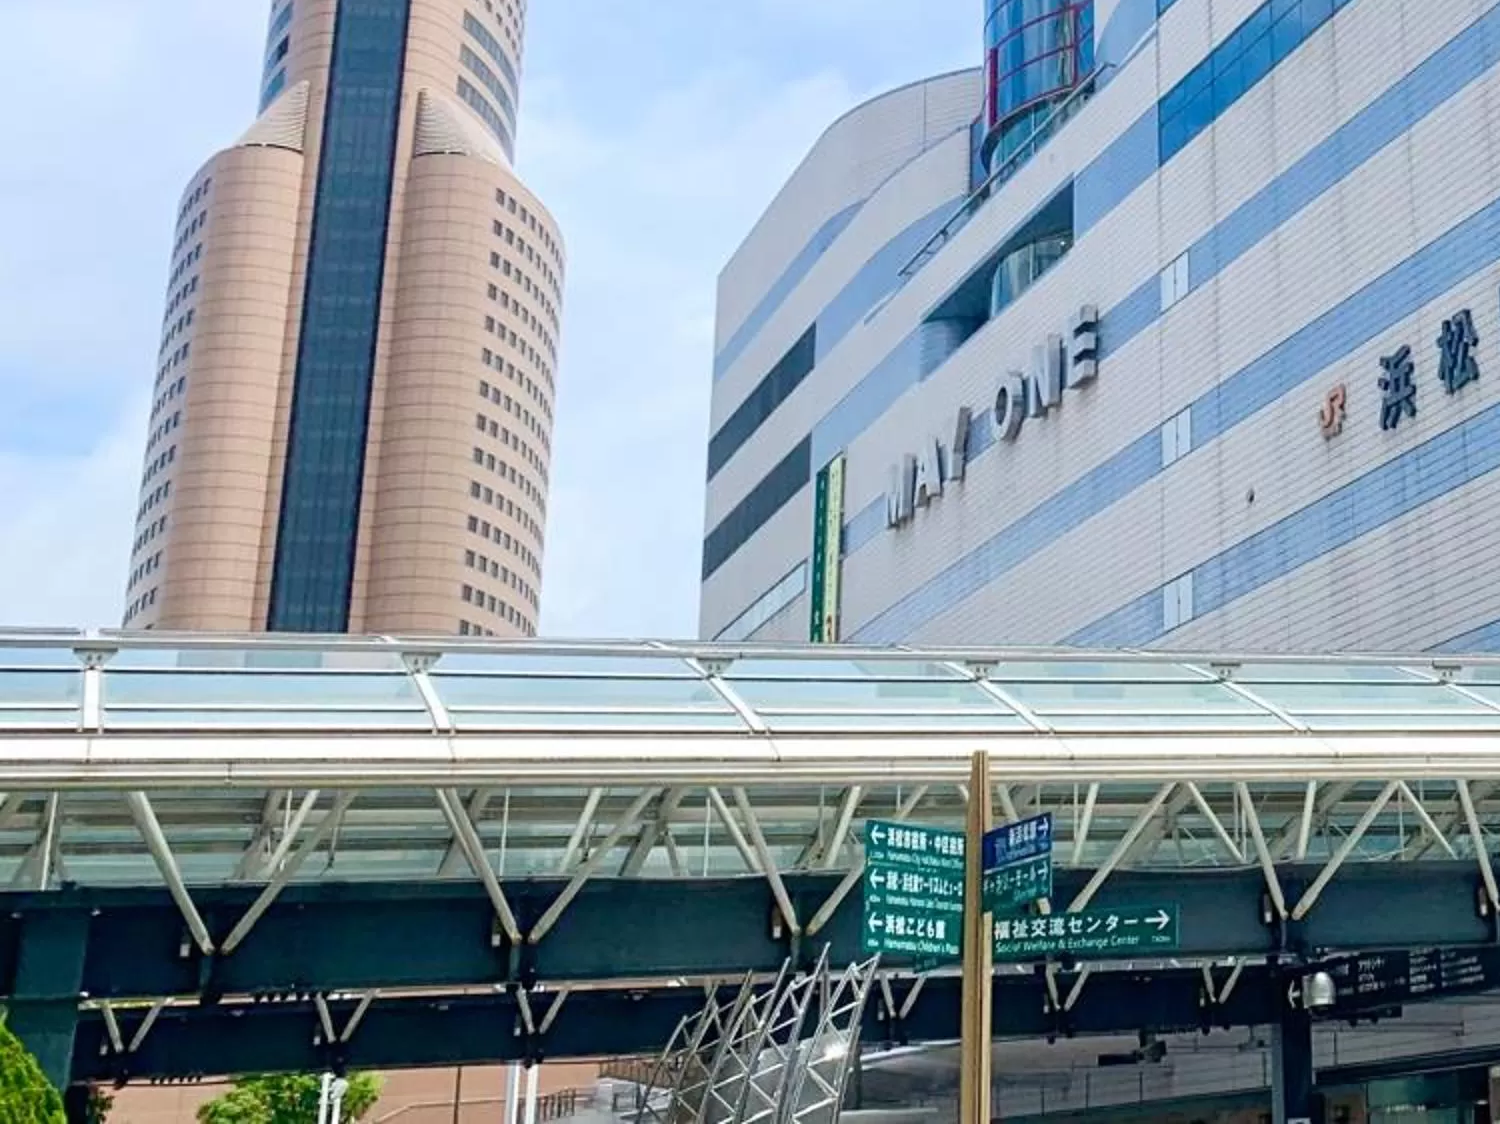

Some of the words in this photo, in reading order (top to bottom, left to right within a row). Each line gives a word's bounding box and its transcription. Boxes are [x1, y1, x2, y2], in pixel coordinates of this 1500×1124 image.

[991, 304, 1099, 444] ONE
[994, 914, 1138, 939] 福祉交流センター
[1067, 936, 1108, 950] Exchange
[1111, 935, 1140, 947] Center
